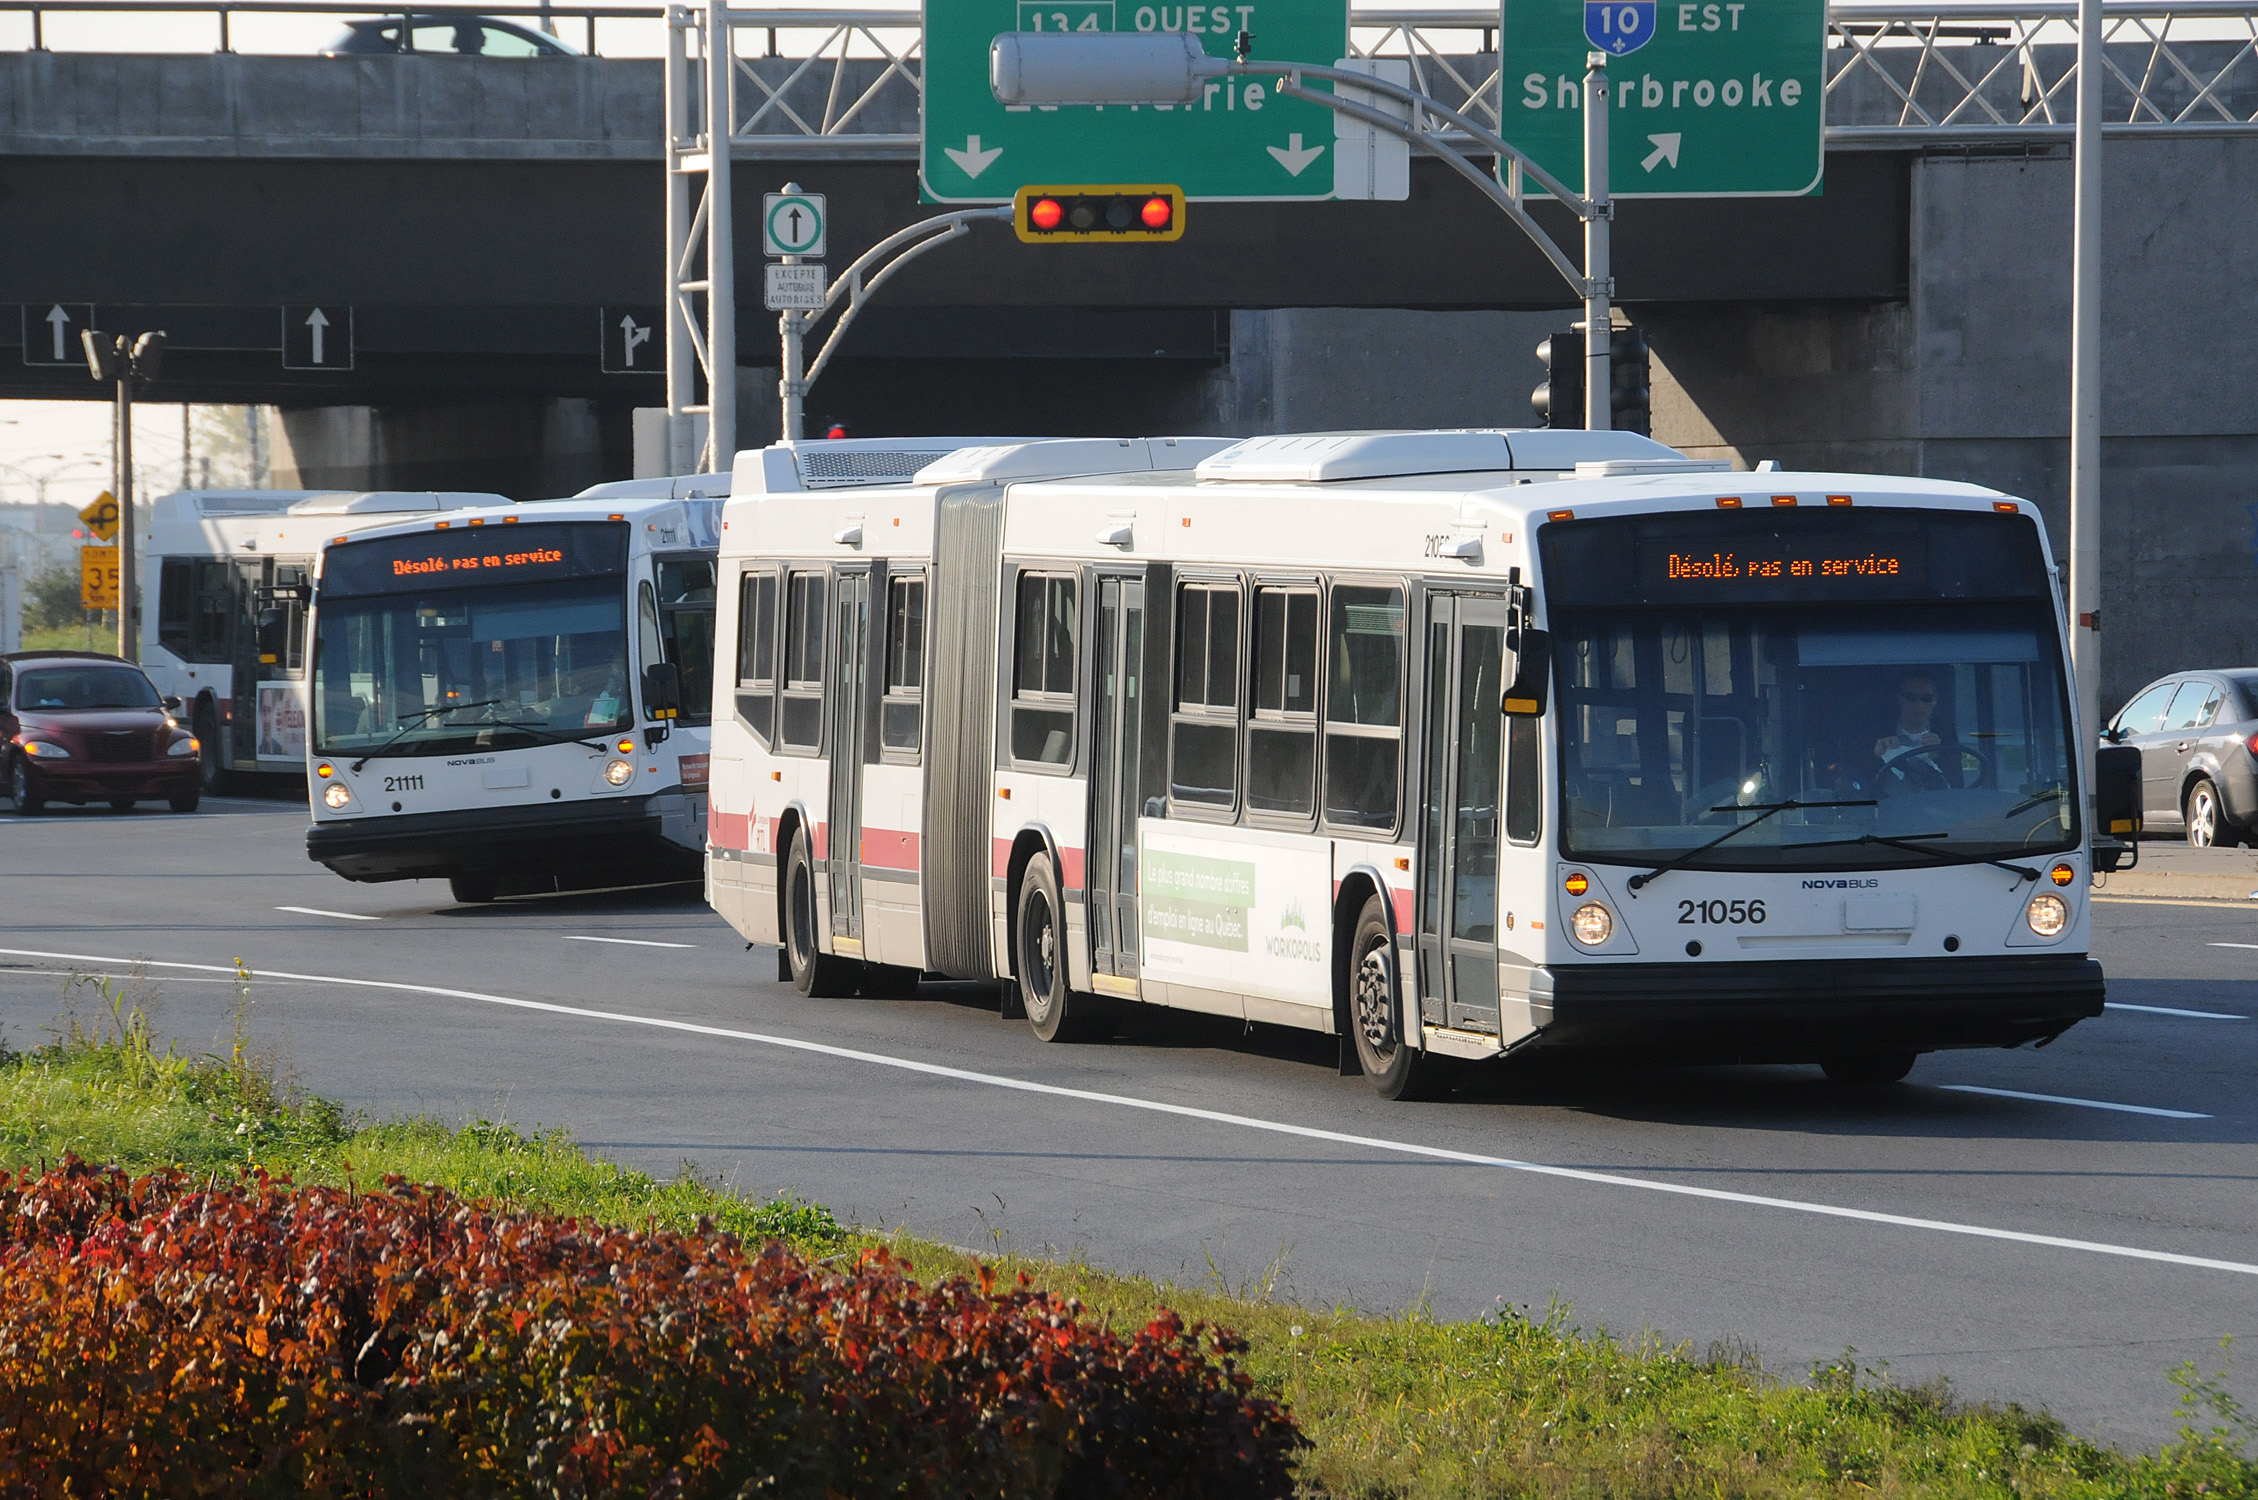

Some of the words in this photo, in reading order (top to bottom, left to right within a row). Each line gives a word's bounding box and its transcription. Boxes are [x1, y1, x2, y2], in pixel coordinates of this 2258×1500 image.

[1135, 6, 1254, 33] OUEST
[1601, 6, 1640, 34] 10
[1678, 4, 1745, 31] EST
[1522, 72, 1802, 109] Shrbrooke
[393, 556, 449, 576] Désolé,
[482, 555, 501, 568] en
[504, 547, 562, 566] service
[1669, 553, 1739, 578] Désolé,
[1790, 560, 1813, 576] en
[1821, 553, 1899, 575] service
[88, 567, 119, 590] 35
[384, 774, 424, 792] 21111
[1147, 860, 1157, 882] Le
[1157, 862, 1174, 888] plus
[1174, 866, 1195, 891] grand
[1195, 868, 1222, 892] nombre
[1147, 903, 1178, 932] d'emploi
[1178, 914, 1187, 929] en
[1187, 909, 1204, 937] ligne
[1205, 918, 1215, 935] au
[1677, 899, 1767, 925] 21056
[1265, 935, 1321, 963] WORKOPOLIS
